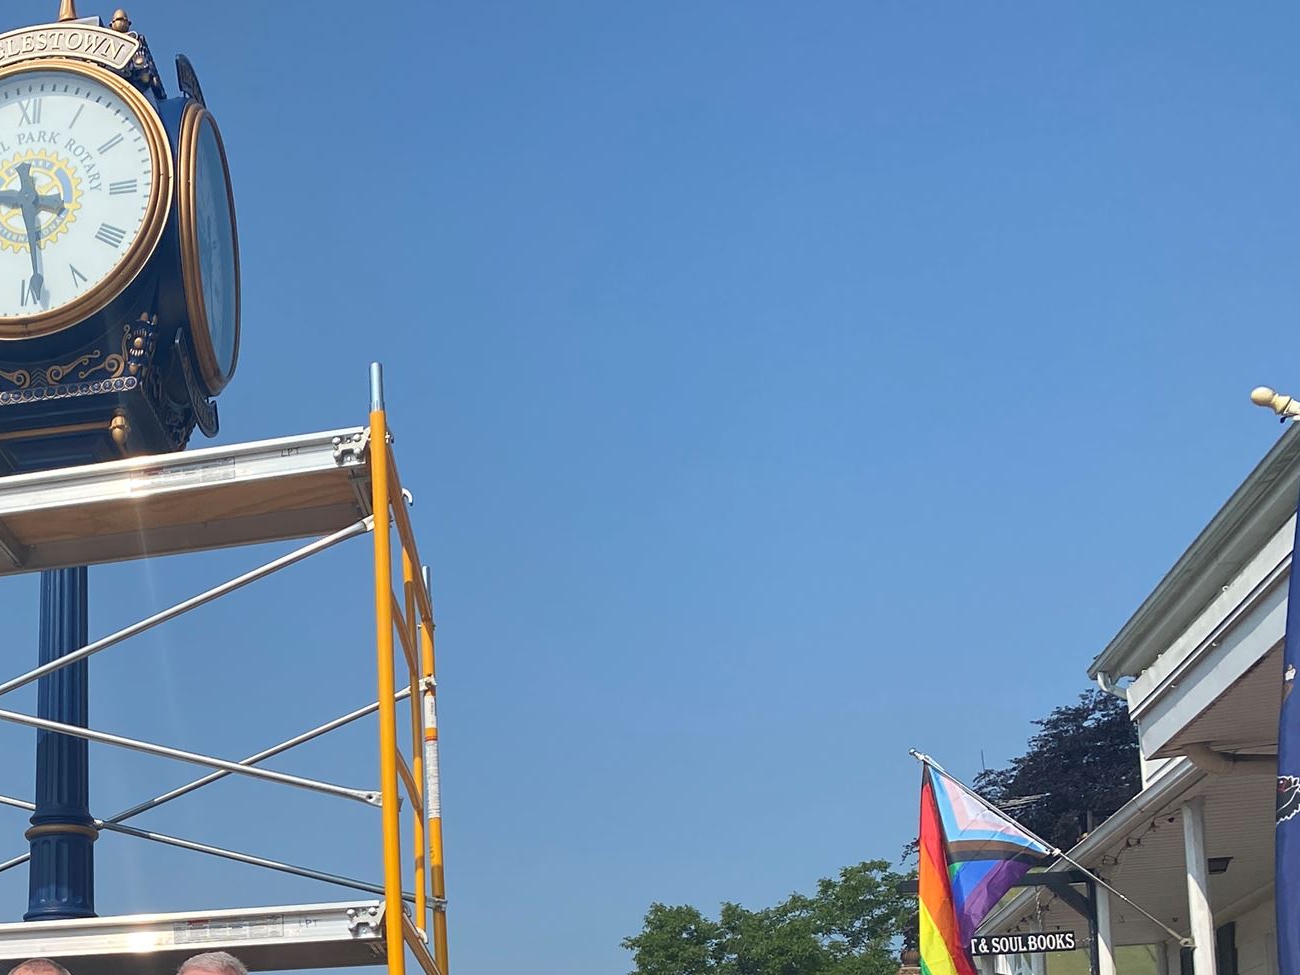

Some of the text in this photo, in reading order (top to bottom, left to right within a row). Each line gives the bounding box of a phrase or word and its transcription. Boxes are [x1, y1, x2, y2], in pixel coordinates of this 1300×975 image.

[18, 98, 42, 126] XII
[17, 130, 61, 146] PARK
[64, 137, 102, 194] ROTARY
[978, 937, 990, 954] &
[992, 936, 1028, 953] SOUL
[1028, 933, 1076, 952] BOOKS
